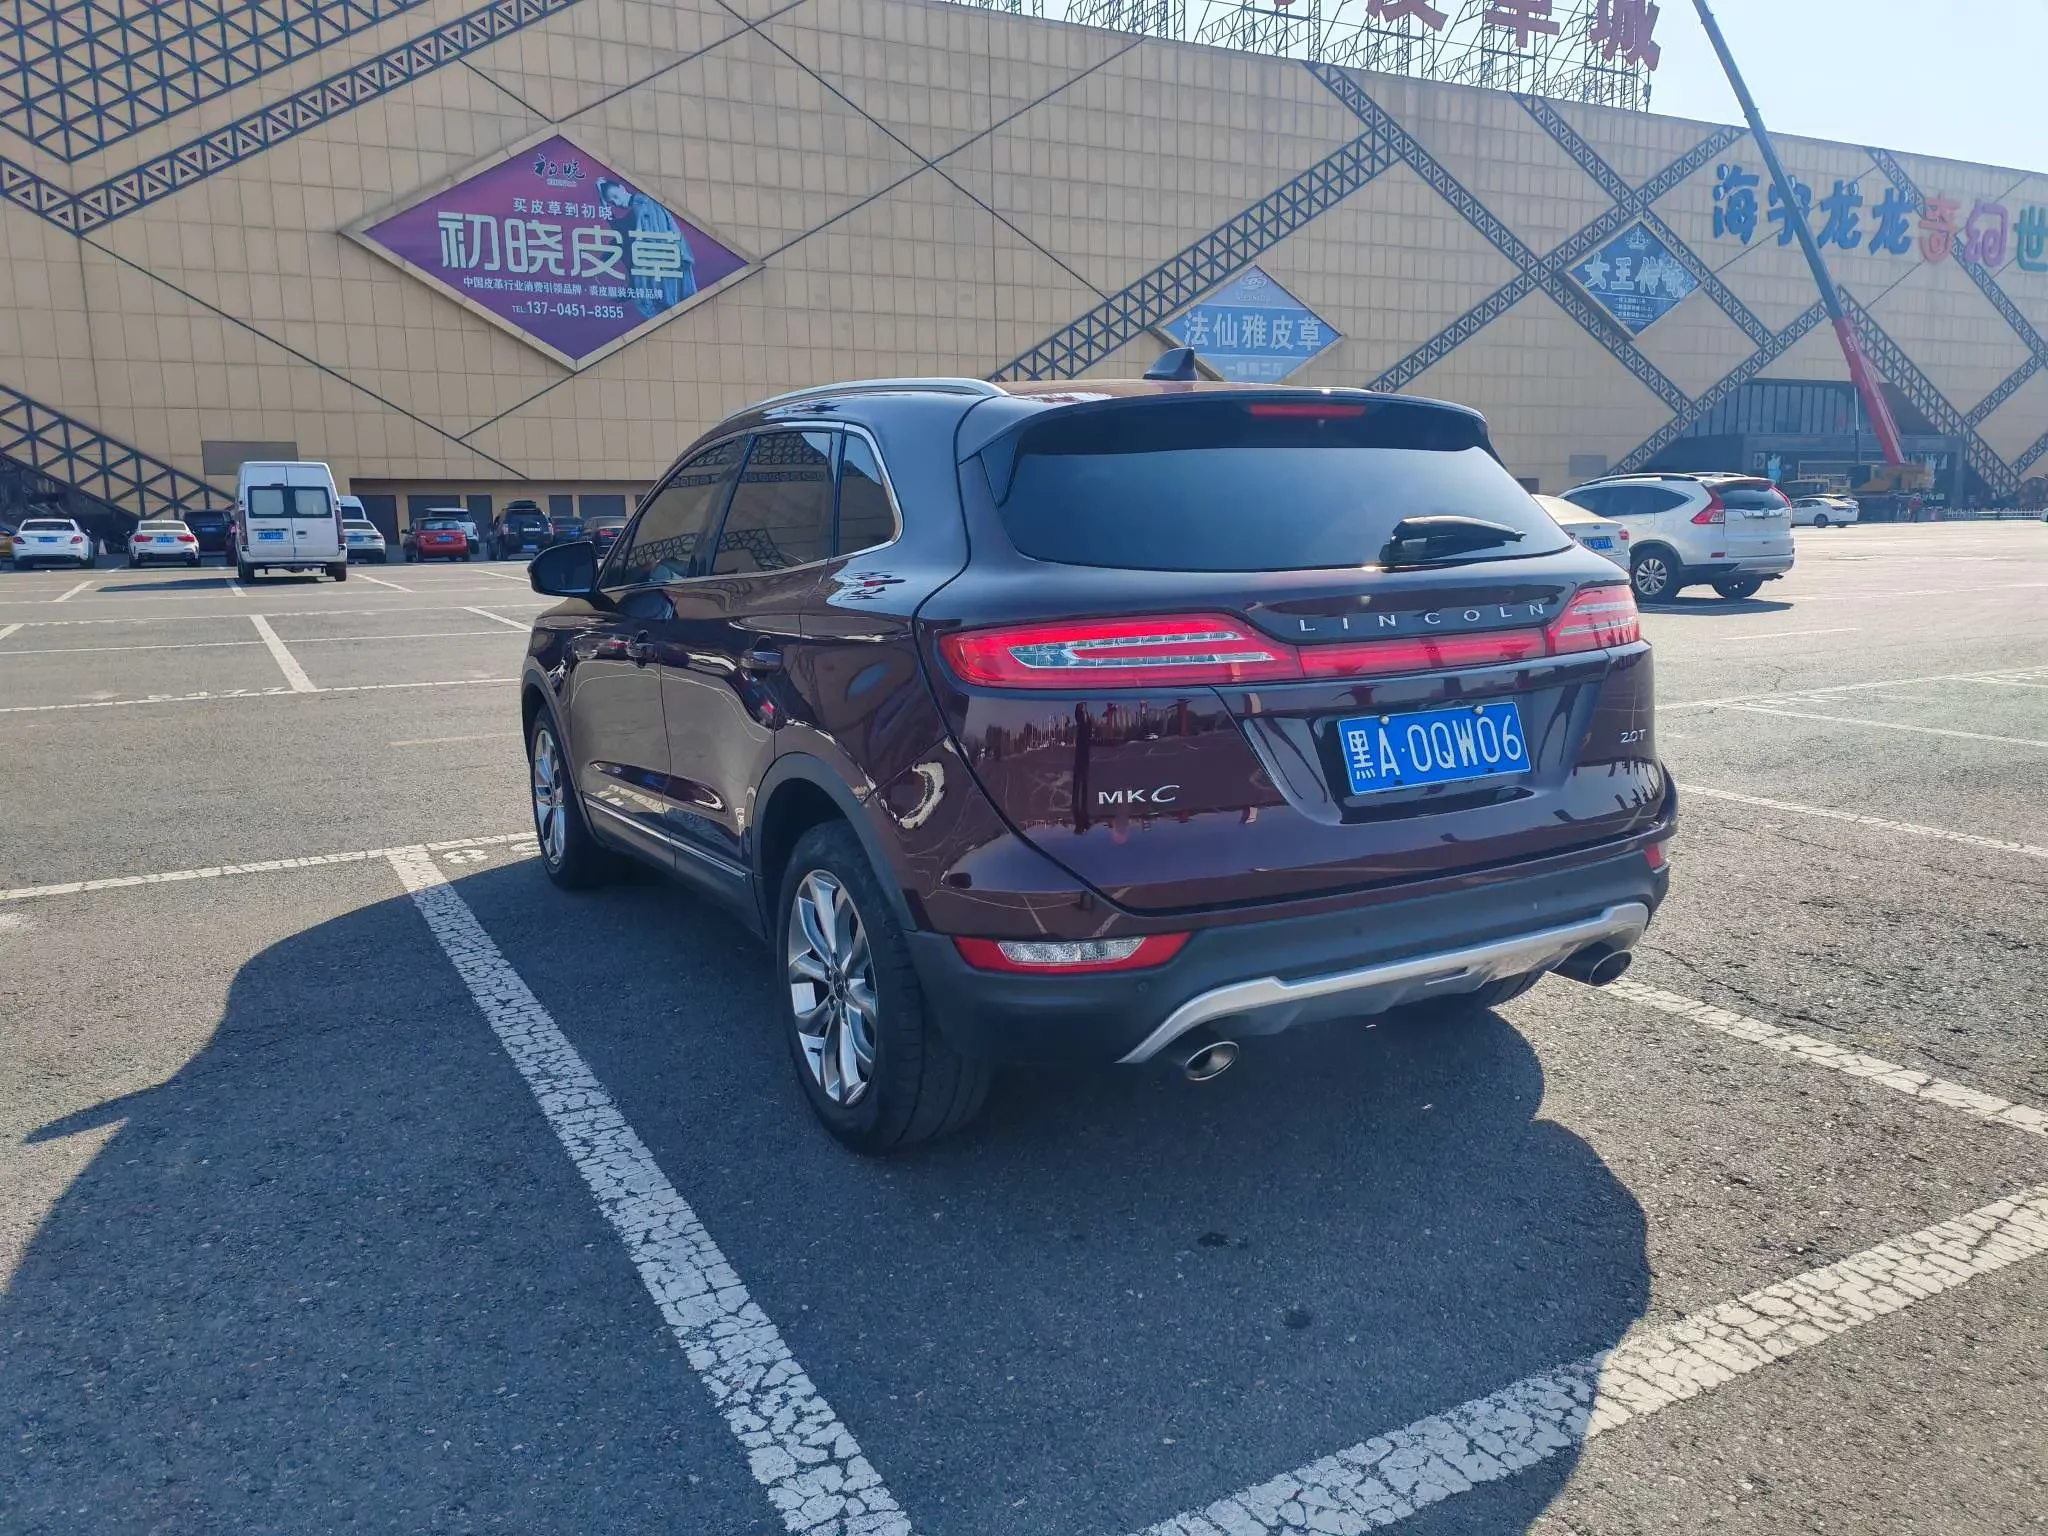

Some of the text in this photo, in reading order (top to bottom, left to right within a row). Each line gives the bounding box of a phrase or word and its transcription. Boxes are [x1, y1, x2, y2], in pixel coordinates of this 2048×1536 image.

[512, 197, 613, 221] 买皮草到初晓
[437, 211, 684, 282] 初晓皮草
[1183, 310, 1322, 351] 法仙雅皮草
[1299, 602, 1544, 632] LINCOLN
[1098, 784, 1181, 805] MKC
